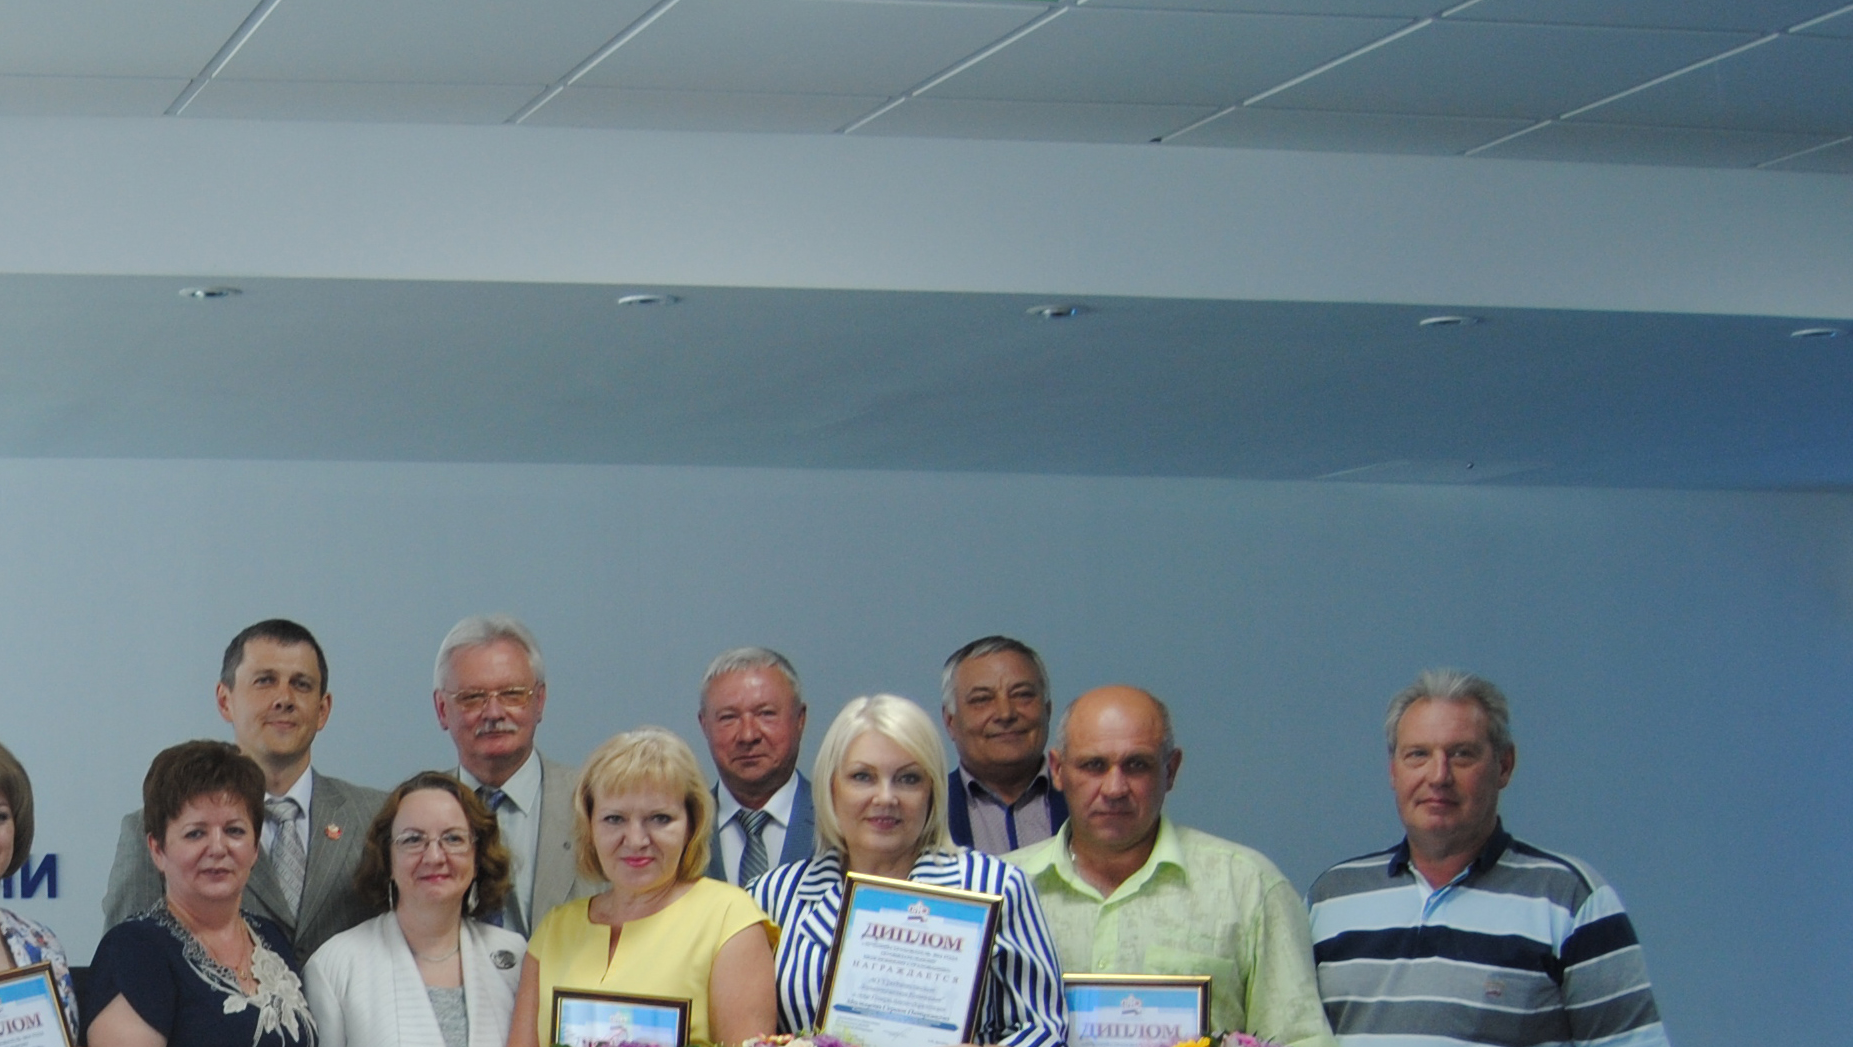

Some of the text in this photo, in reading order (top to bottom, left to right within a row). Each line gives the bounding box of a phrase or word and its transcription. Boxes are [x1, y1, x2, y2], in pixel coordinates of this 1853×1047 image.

[861, 922, 965, 952] ДИПЛОМ
[852, 960, 960, 984] НАГРАЖДАЕТСЯ
[1079, 1022, 1182, 1040] ДИПЛОМ
